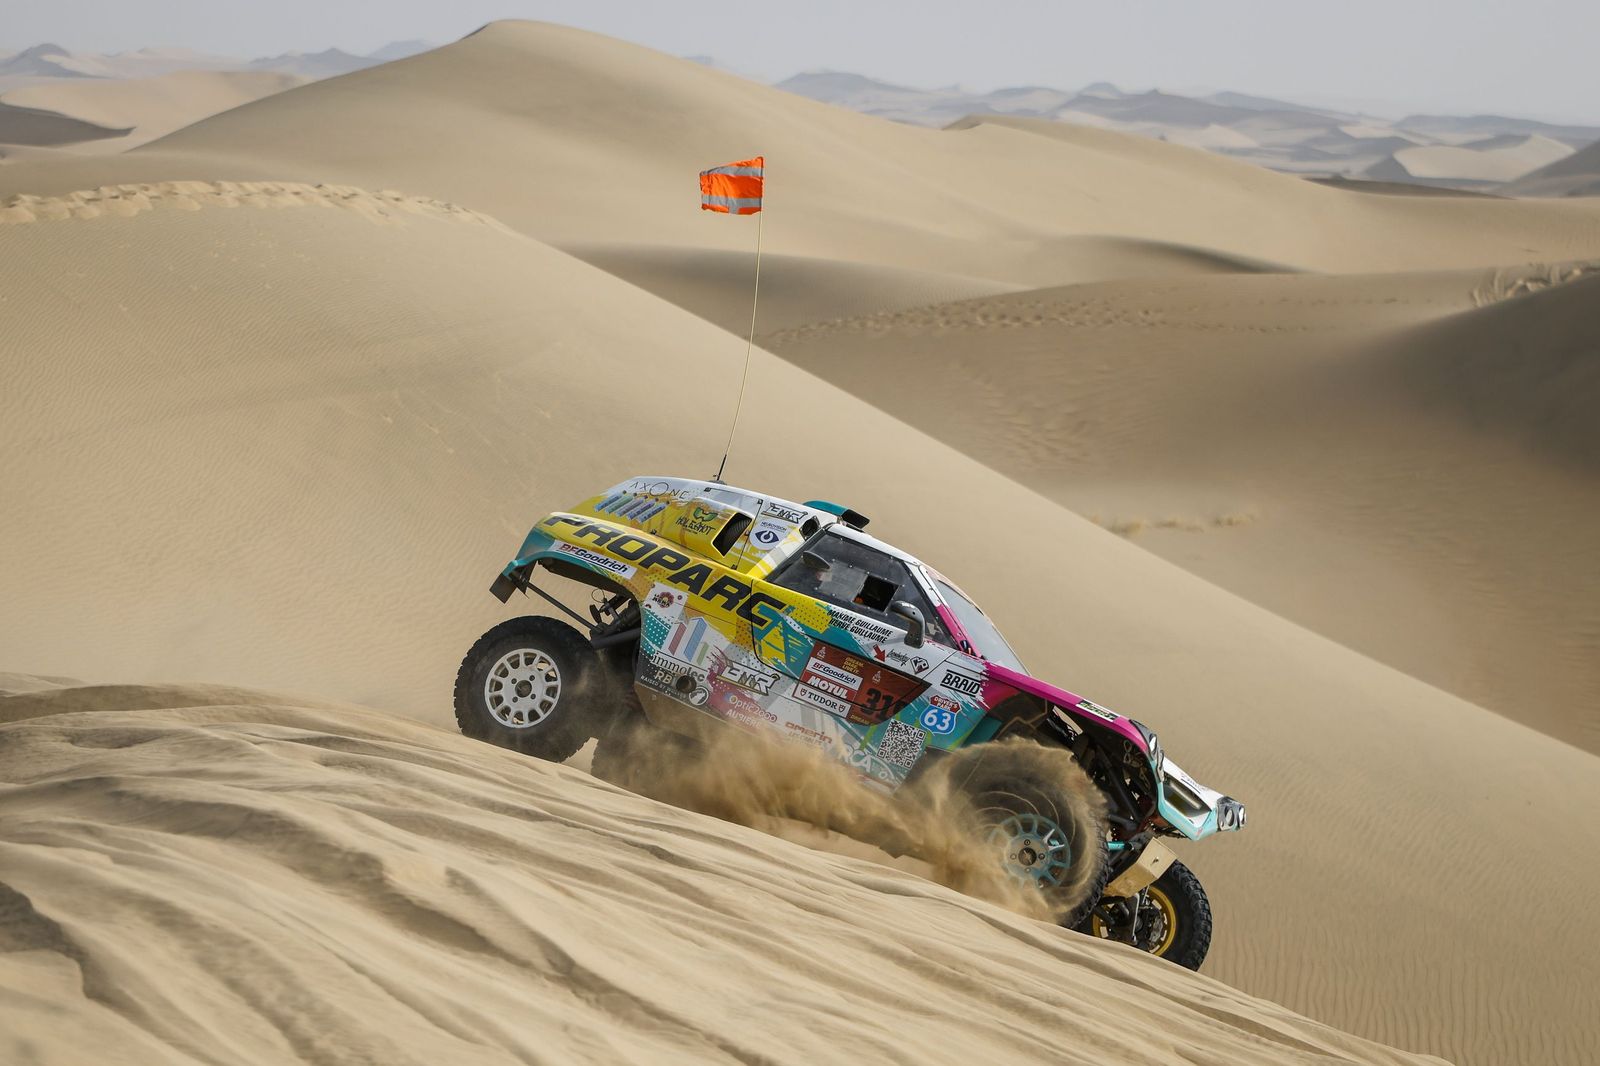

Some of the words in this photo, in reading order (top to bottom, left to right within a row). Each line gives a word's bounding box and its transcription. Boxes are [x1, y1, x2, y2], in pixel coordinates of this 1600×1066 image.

[560, 543, 629, 573] BFGoodrich
[544, 516, 788, 627] PROPARC
[828, 610, 855, 625] MAXIME
[855, 618, 893, 637] GUILLAUME
[850, 626, 888, 643] GUILLAUME
[812, 662, 857, 684] BFGoodrich
[941, 672, 981, 695] BRAID
[807, 676, 848, 698] MOTUL
[808, 690, 838, 710] TUDOR
[924, 709, 952, 731] 63
